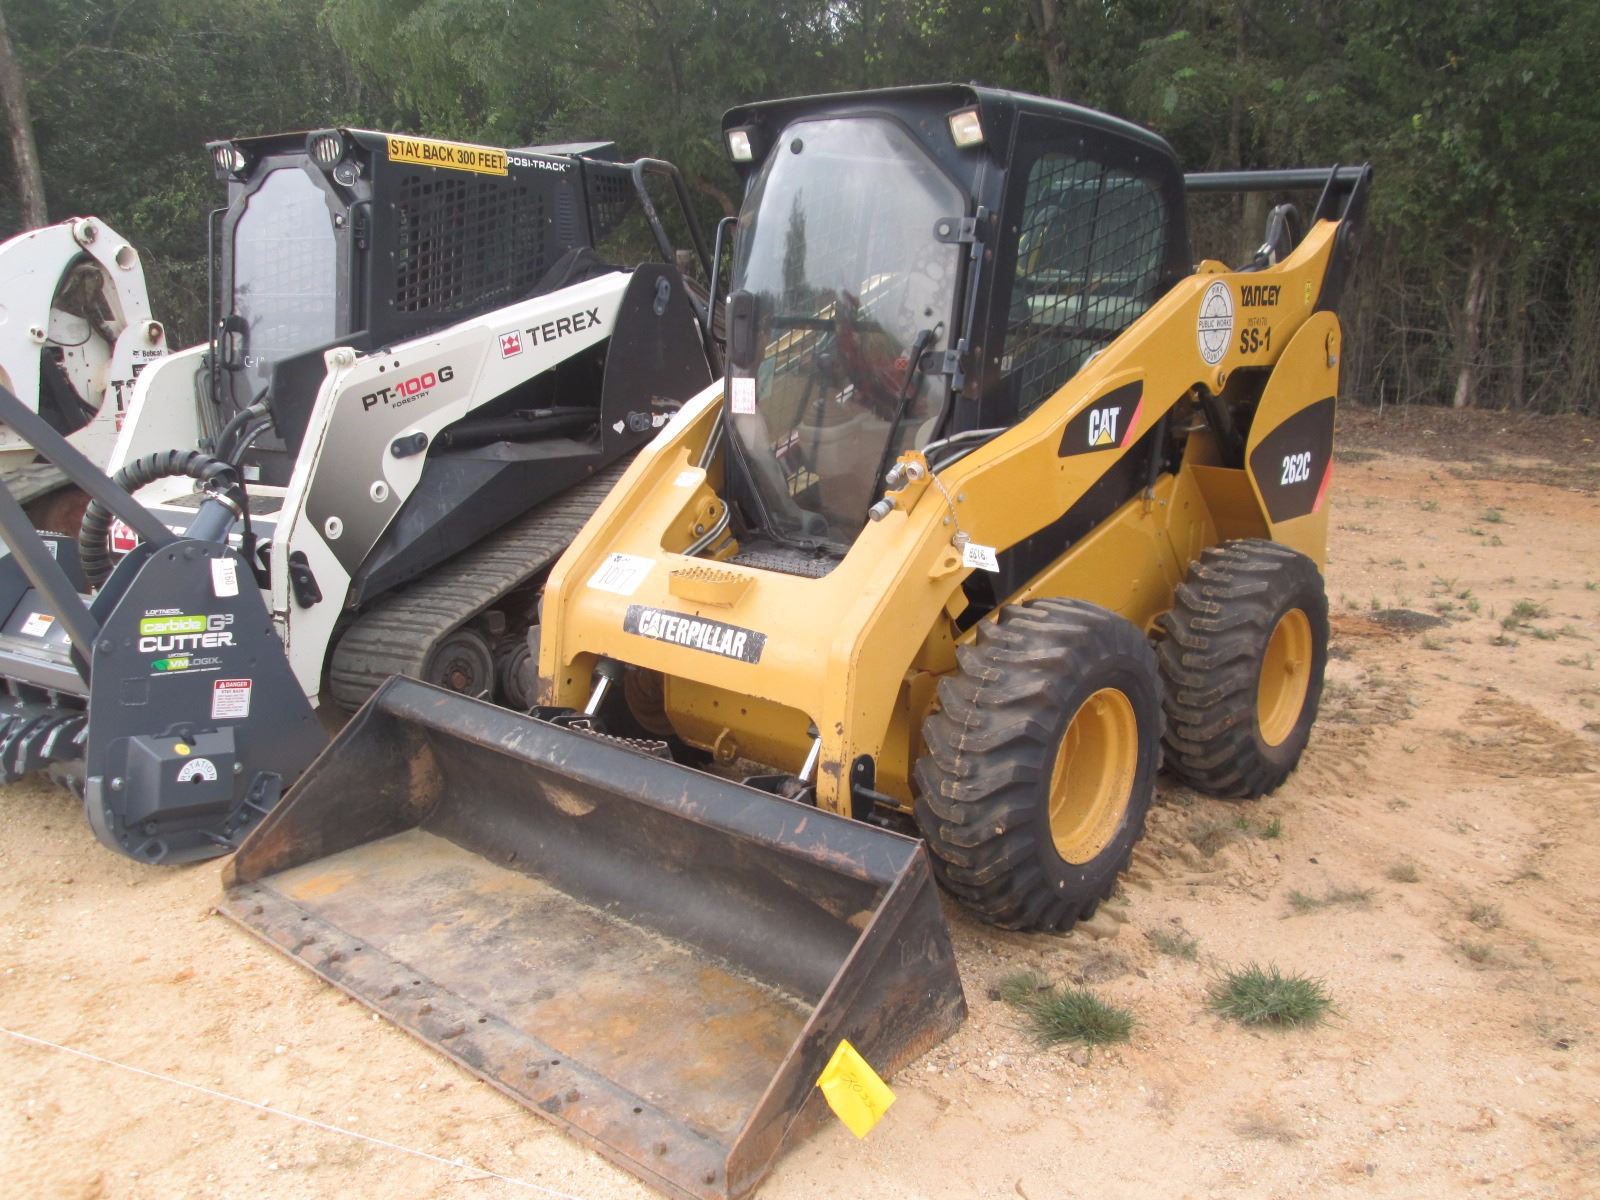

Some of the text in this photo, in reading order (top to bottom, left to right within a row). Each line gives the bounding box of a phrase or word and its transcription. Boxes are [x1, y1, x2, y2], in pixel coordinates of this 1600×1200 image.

[391, 139, 504, 169] STAY BACK 300 FEET
[507, 156, 566, 172] POSI-TRACK
[1241, 285, 1281, 307] YANCEY
[525, 307, 602, 346] TEREX
[1199, 318, 1232, 329] PUBLIC WORKS
[1240, 326, 1272, 354] SS-1
[142, 350, 163, 358] Bobcat
[392, 391, 430, 408] FORESTRY
[1088, 407, 1120, 446] CAT
[1280, 451, 1311, 485] 262C
[143, 618, 202, 632] carbide
[638, 610, 747, 653] CATERPILLAR
[139, 631, 234, 652] CUTTER
[179, 760, 217, 781] ROTATION
